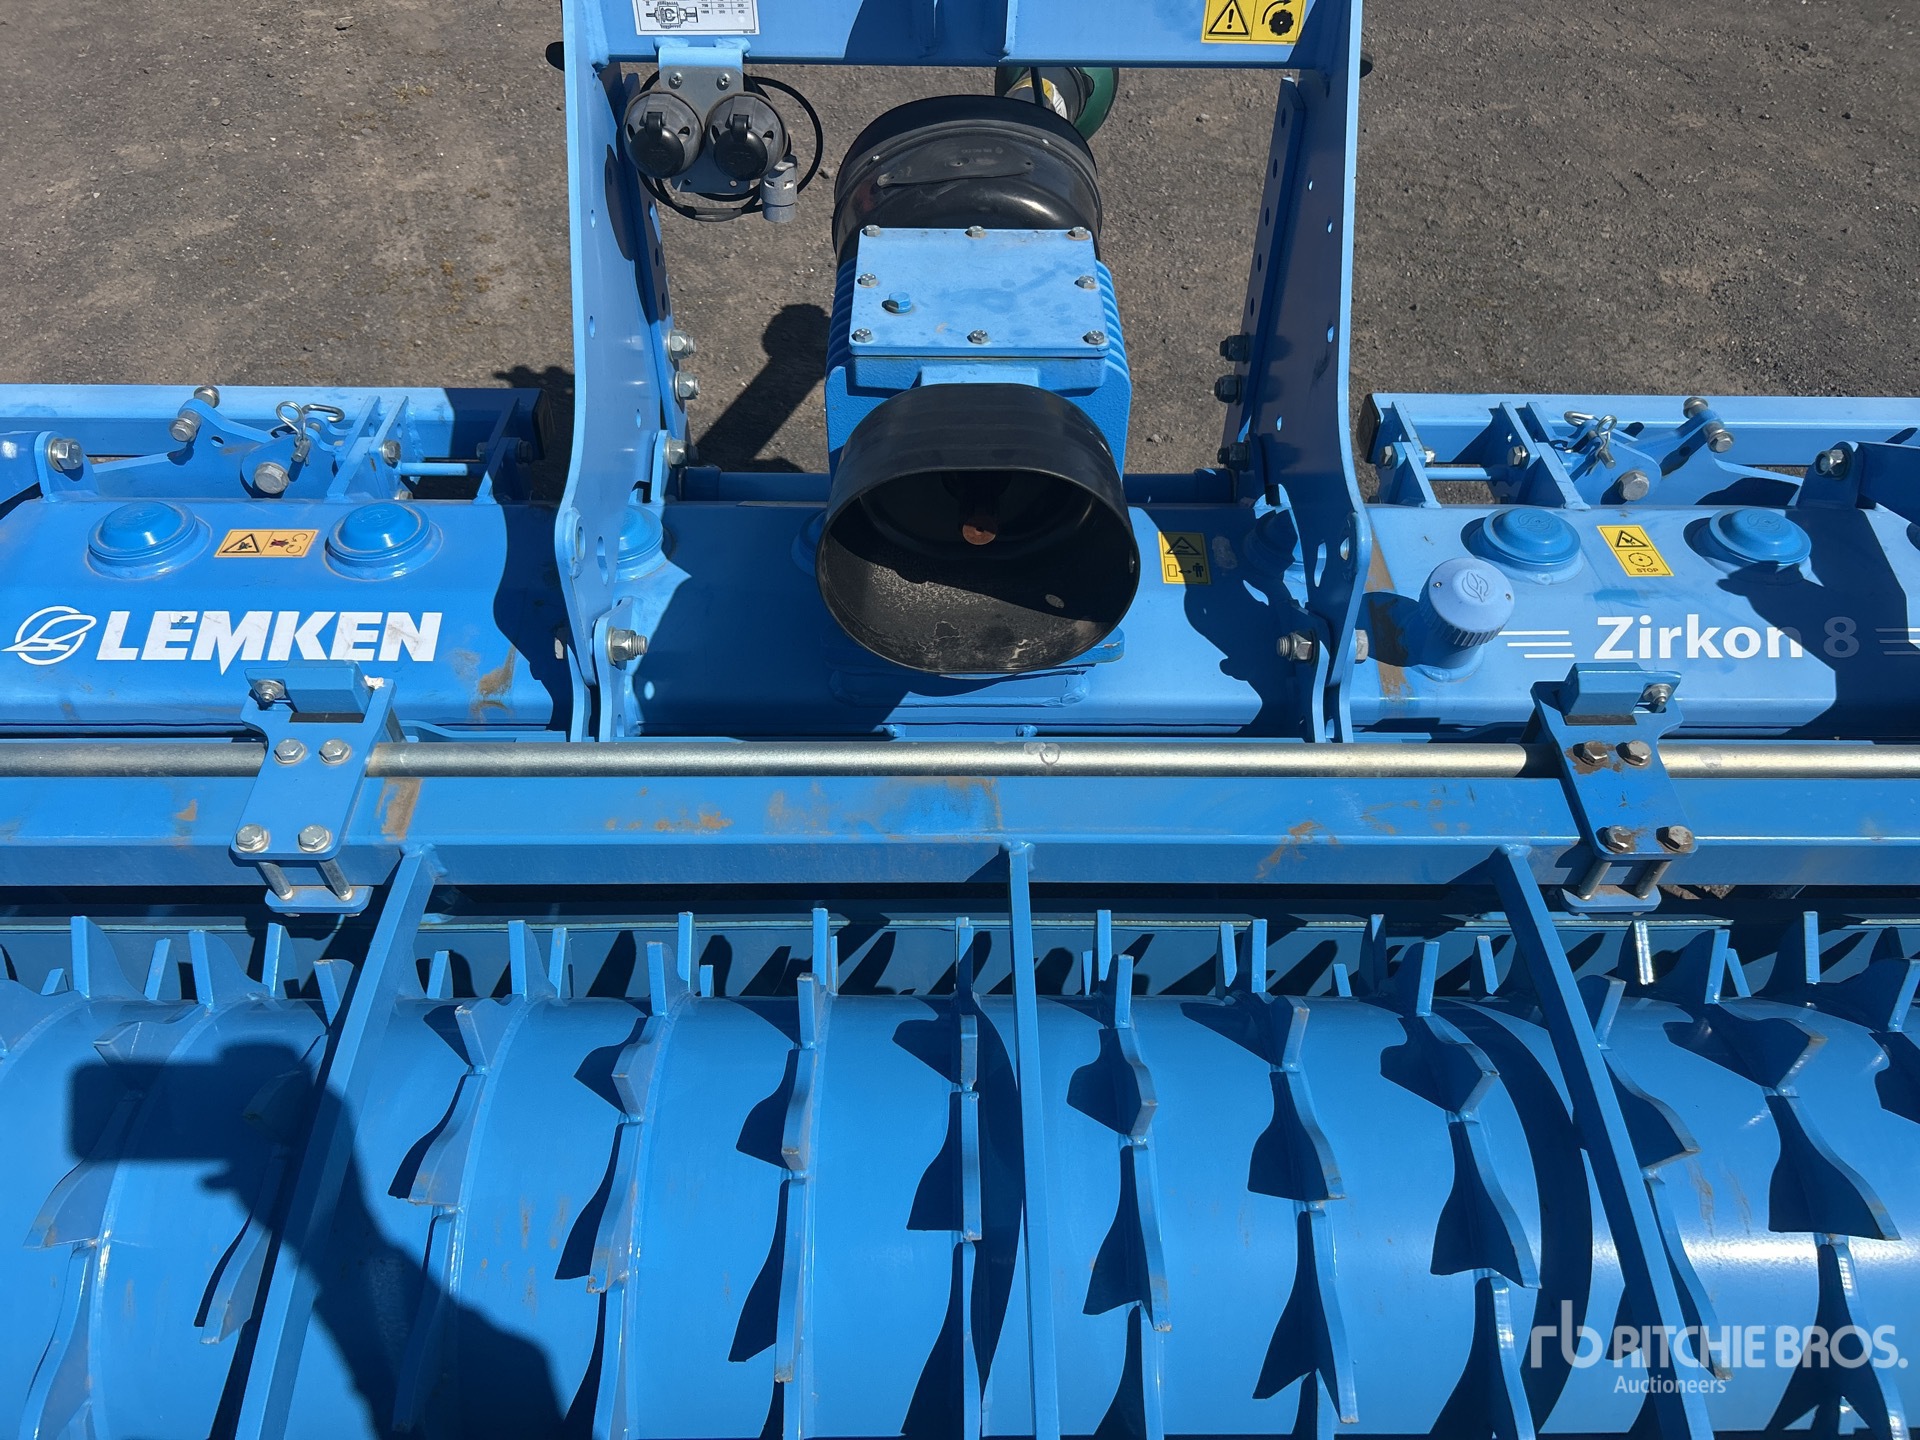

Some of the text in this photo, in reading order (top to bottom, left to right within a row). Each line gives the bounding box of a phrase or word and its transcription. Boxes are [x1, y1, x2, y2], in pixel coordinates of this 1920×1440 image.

[96, 610, 442, 675] LEMKEN
[1594, 614, 1860, 659] Zirkon 8
